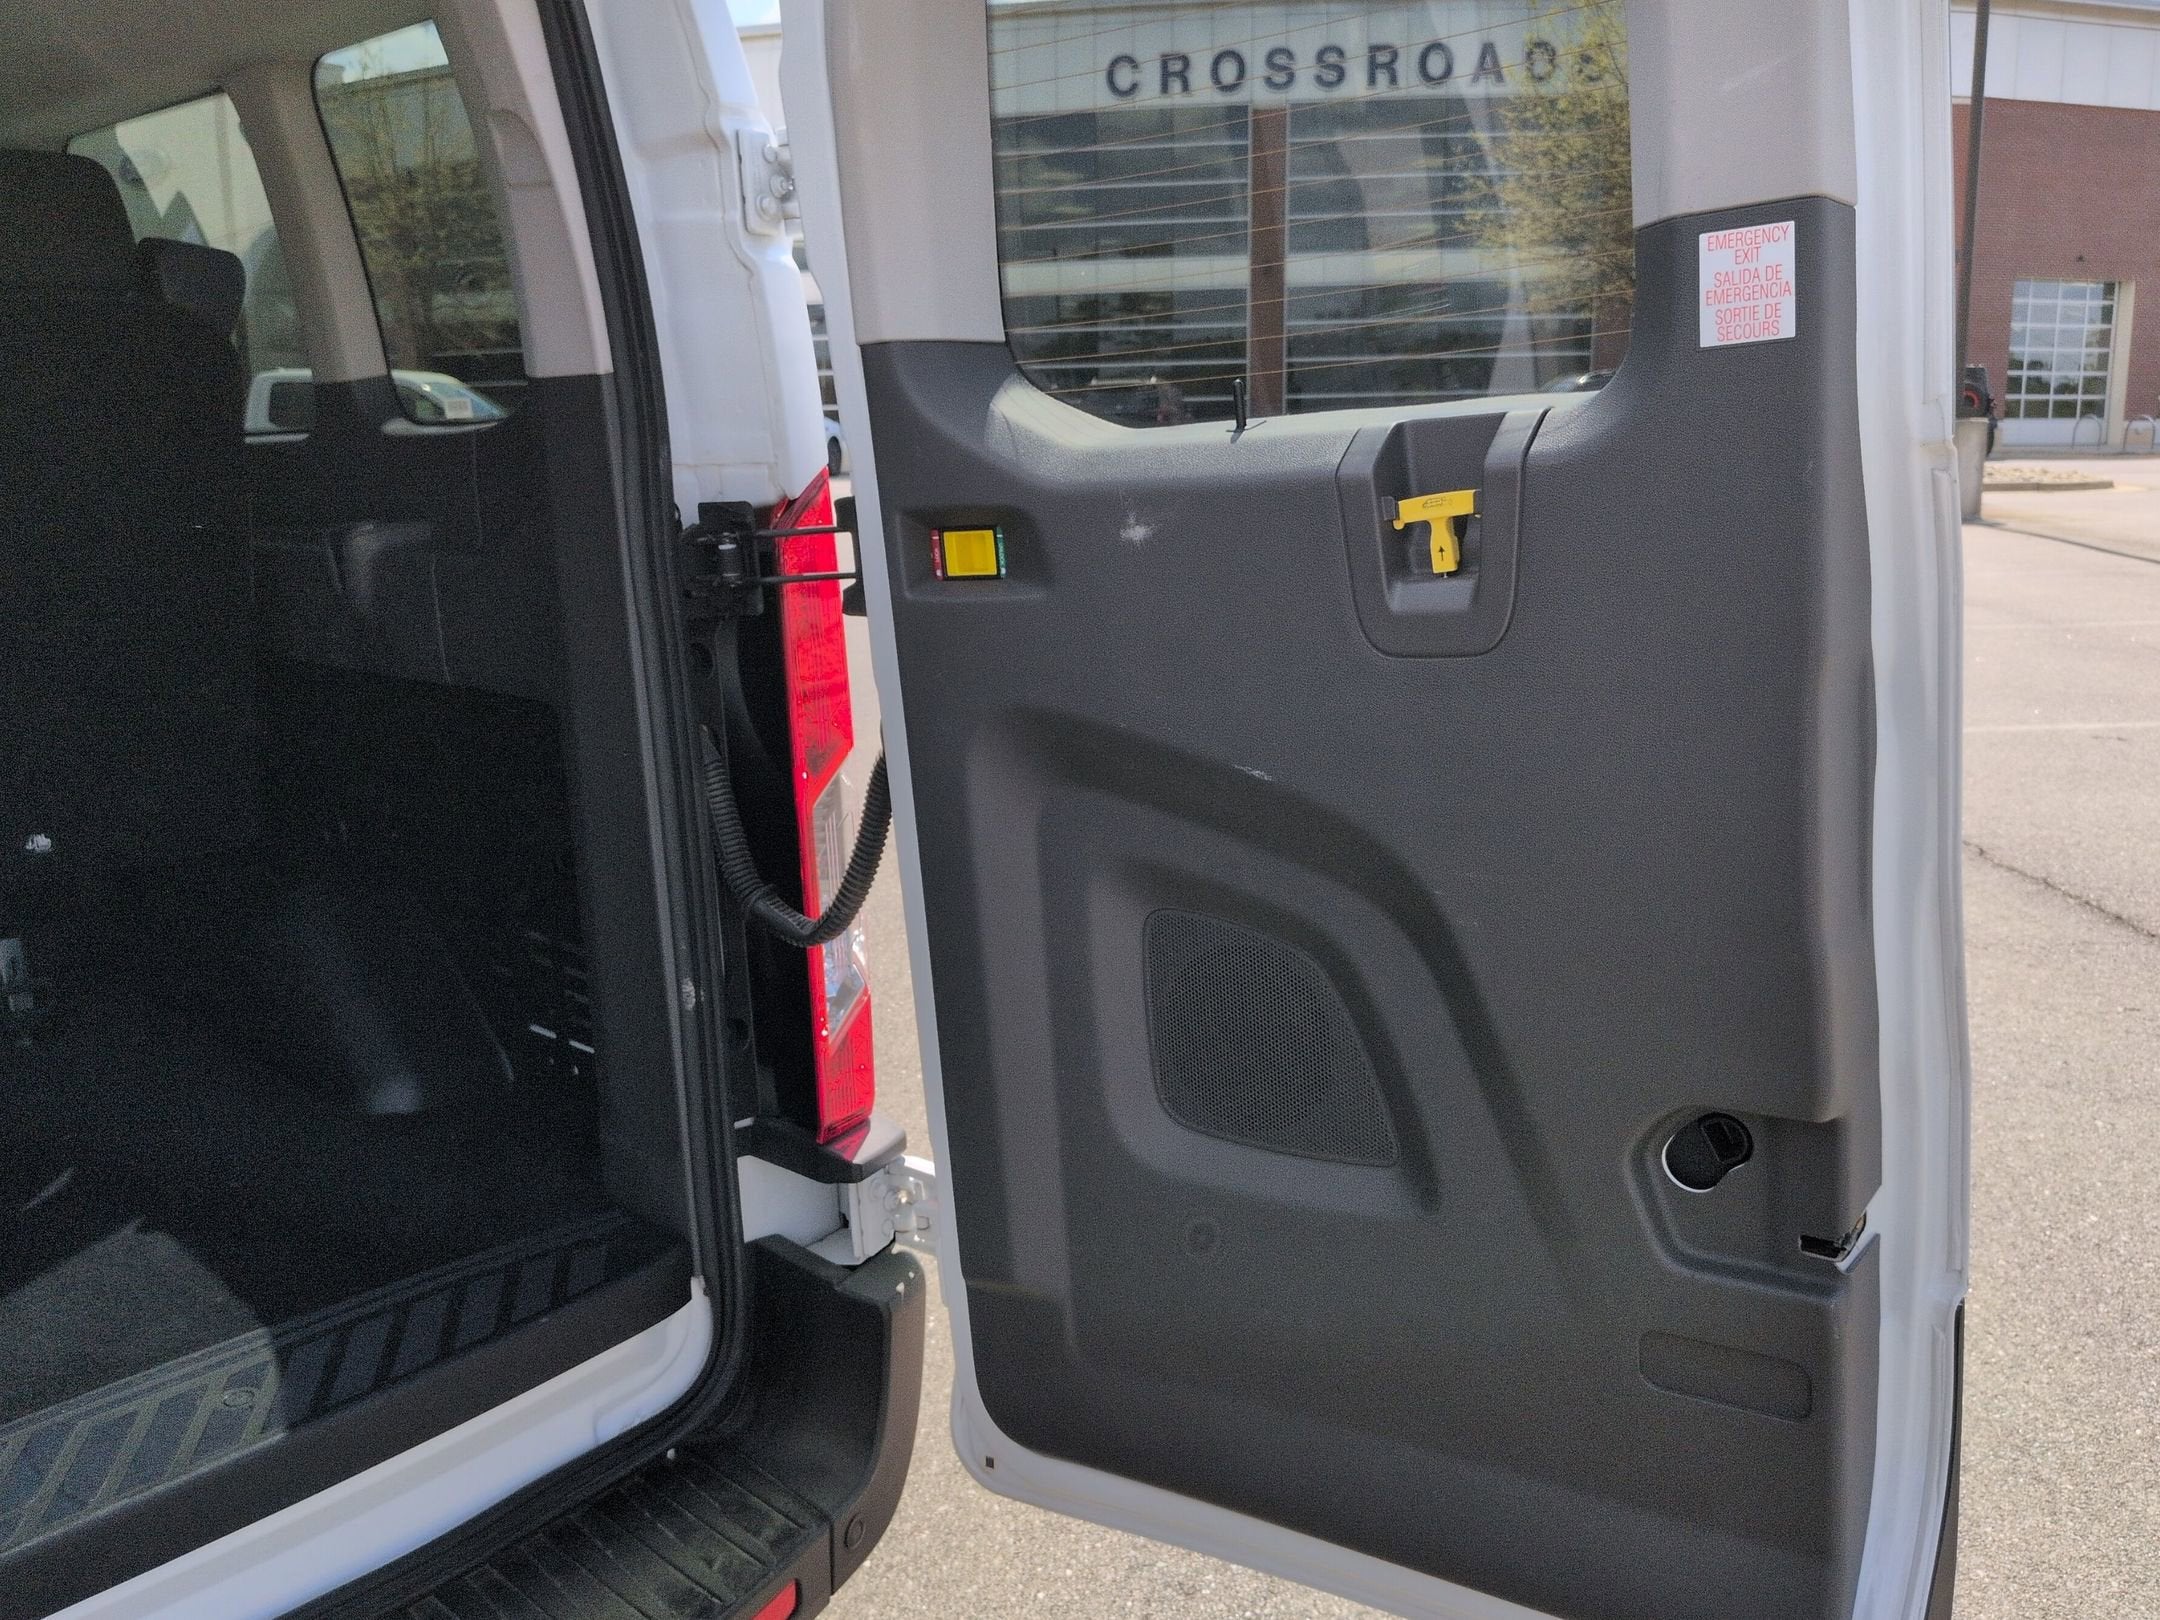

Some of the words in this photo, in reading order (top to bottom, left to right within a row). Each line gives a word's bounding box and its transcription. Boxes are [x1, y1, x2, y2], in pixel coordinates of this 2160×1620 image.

[1707, 225, 1790, 252] EMERGENCY
[1735, 246, 1761, 265] EXIT
[1714, 268, 1760, 288] SALIDA
[1765, 264, 1783, 282] DE
[1706, 281, 1792, 306] EMERGENCIA
[1715, 305, 1760, 325] SORTIE
[1764, 303, 1782, 320] DE
[1717, 320, 1780, 342] SECOURS
